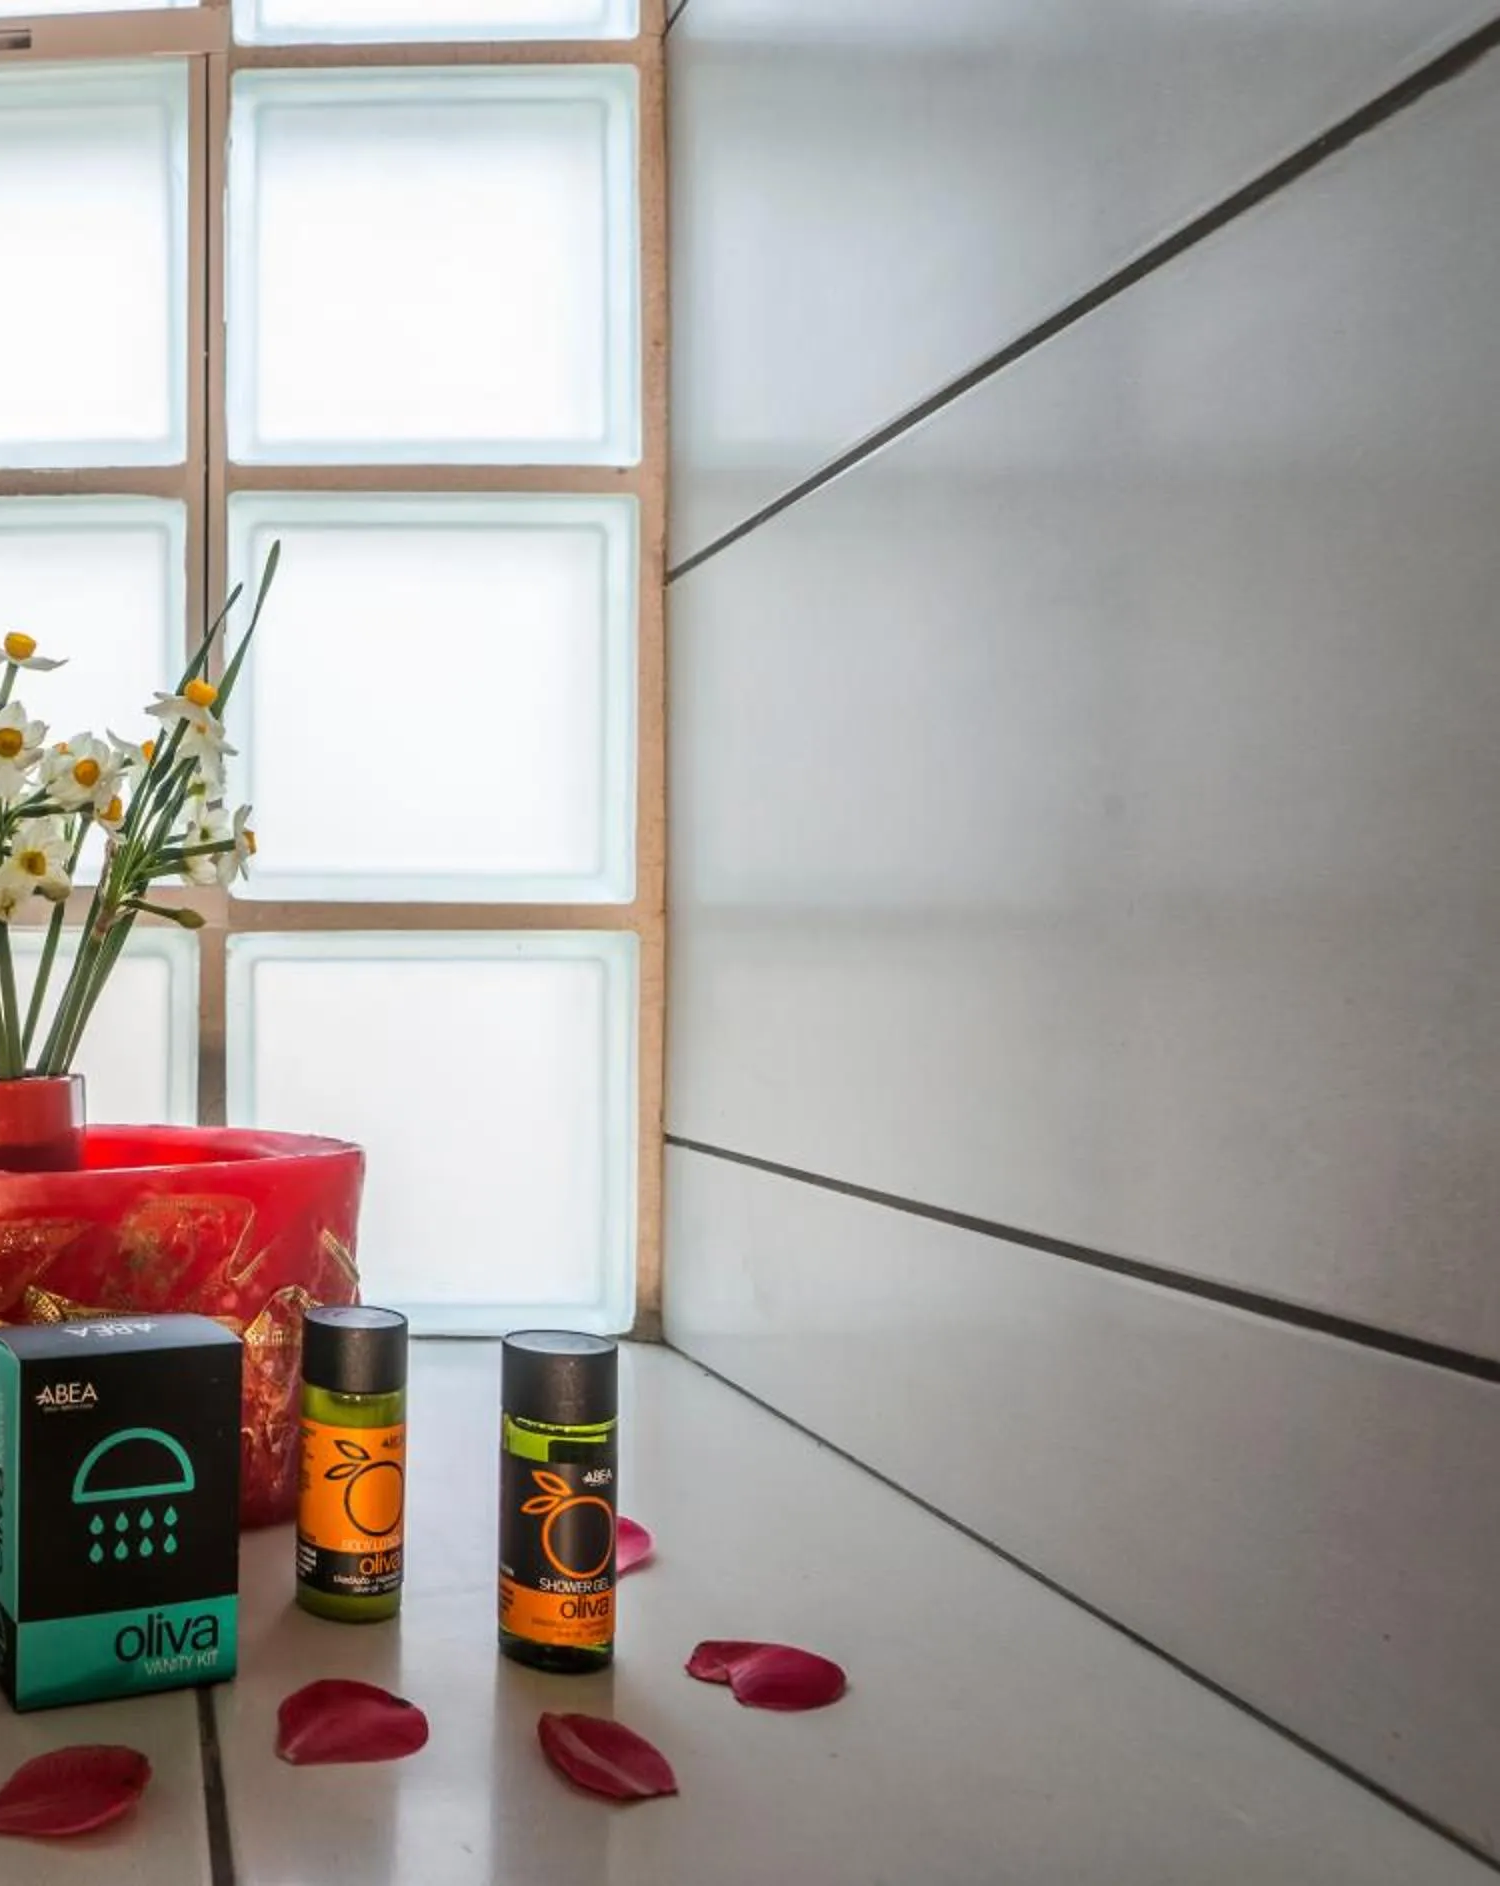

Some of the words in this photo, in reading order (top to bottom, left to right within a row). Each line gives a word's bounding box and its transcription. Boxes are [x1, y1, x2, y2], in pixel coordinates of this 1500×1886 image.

[35, 1382, 98, 1405] ABEA
[360, 1551, 400, 1576] oliva
[540, 1577, 592, 1594] SHOWER
[594, 1578, 610, 1592] GEL
[560, 1595, 609, 1620] oliva
[115, 1612, 219, 1662] oliva
[143, 1655, 194, 1676] VANITY
[197, 1649, 219, 1668] KIT
